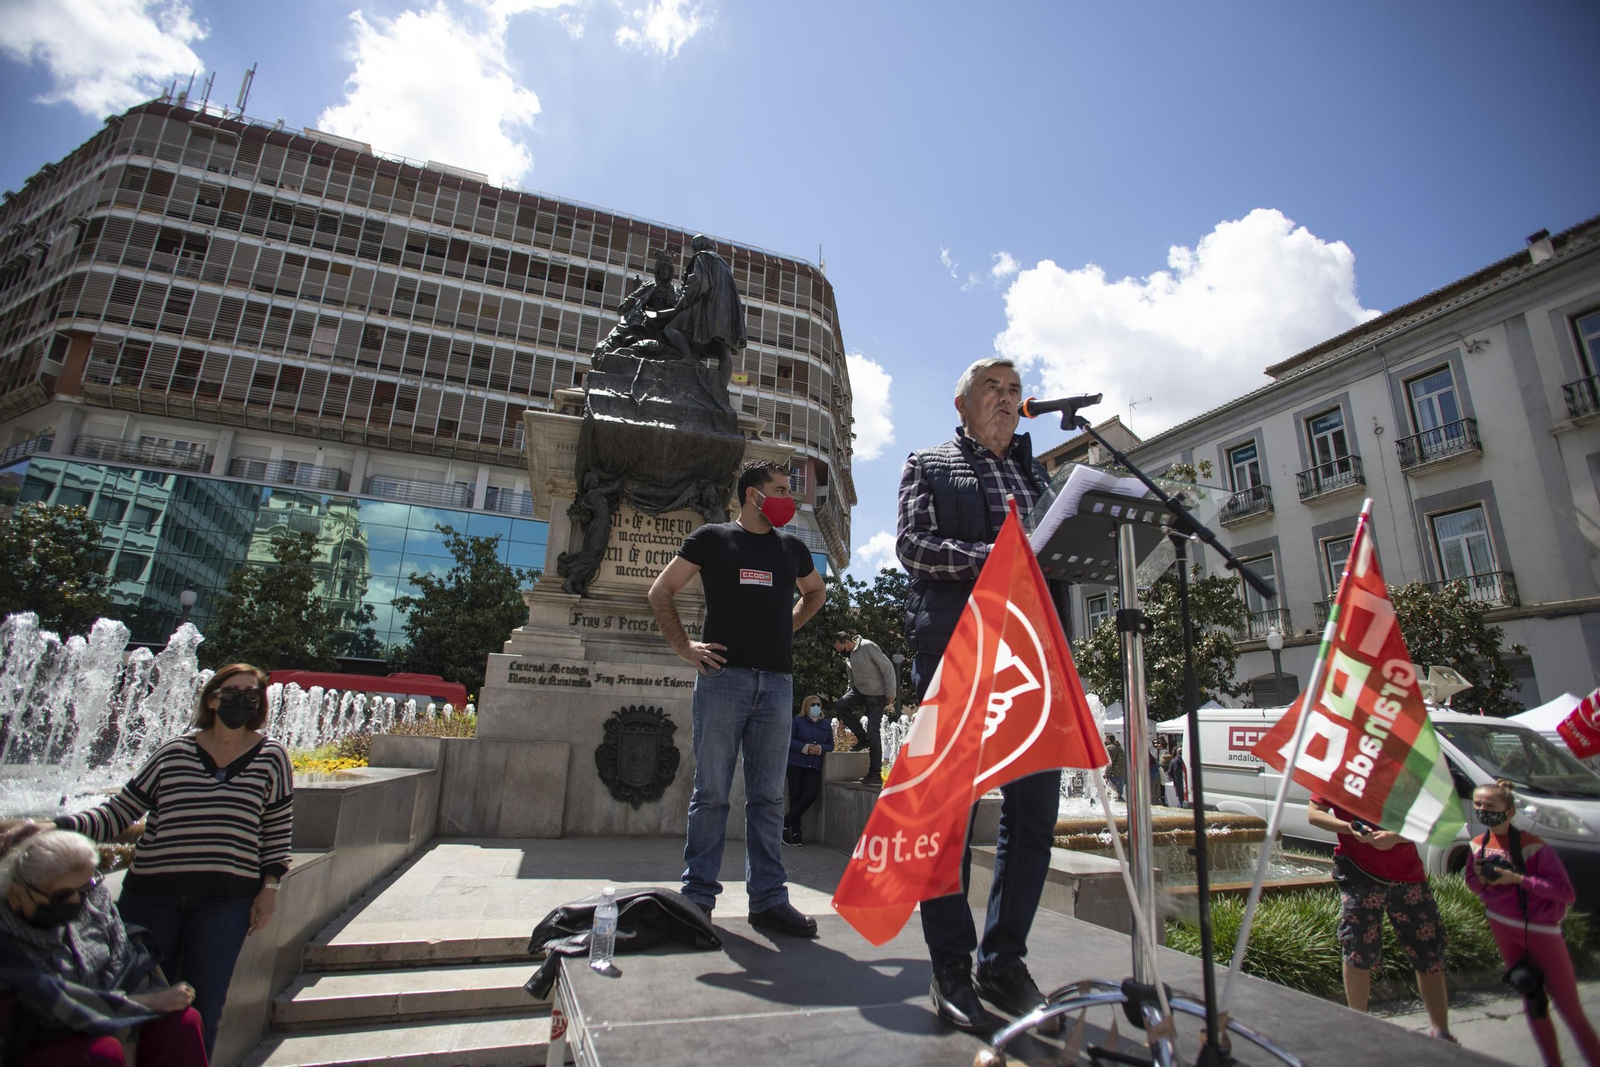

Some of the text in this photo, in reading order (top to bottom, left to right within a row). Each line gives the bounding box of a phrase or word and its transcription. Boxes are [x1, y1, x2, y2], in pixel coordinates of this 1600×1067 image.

[570, 611, 600, 628] Fray
[594, 672, 614, 686] Fray
[663, 676, 695, 688] Talaver
[852, 829, 940, 873] ugt.es
